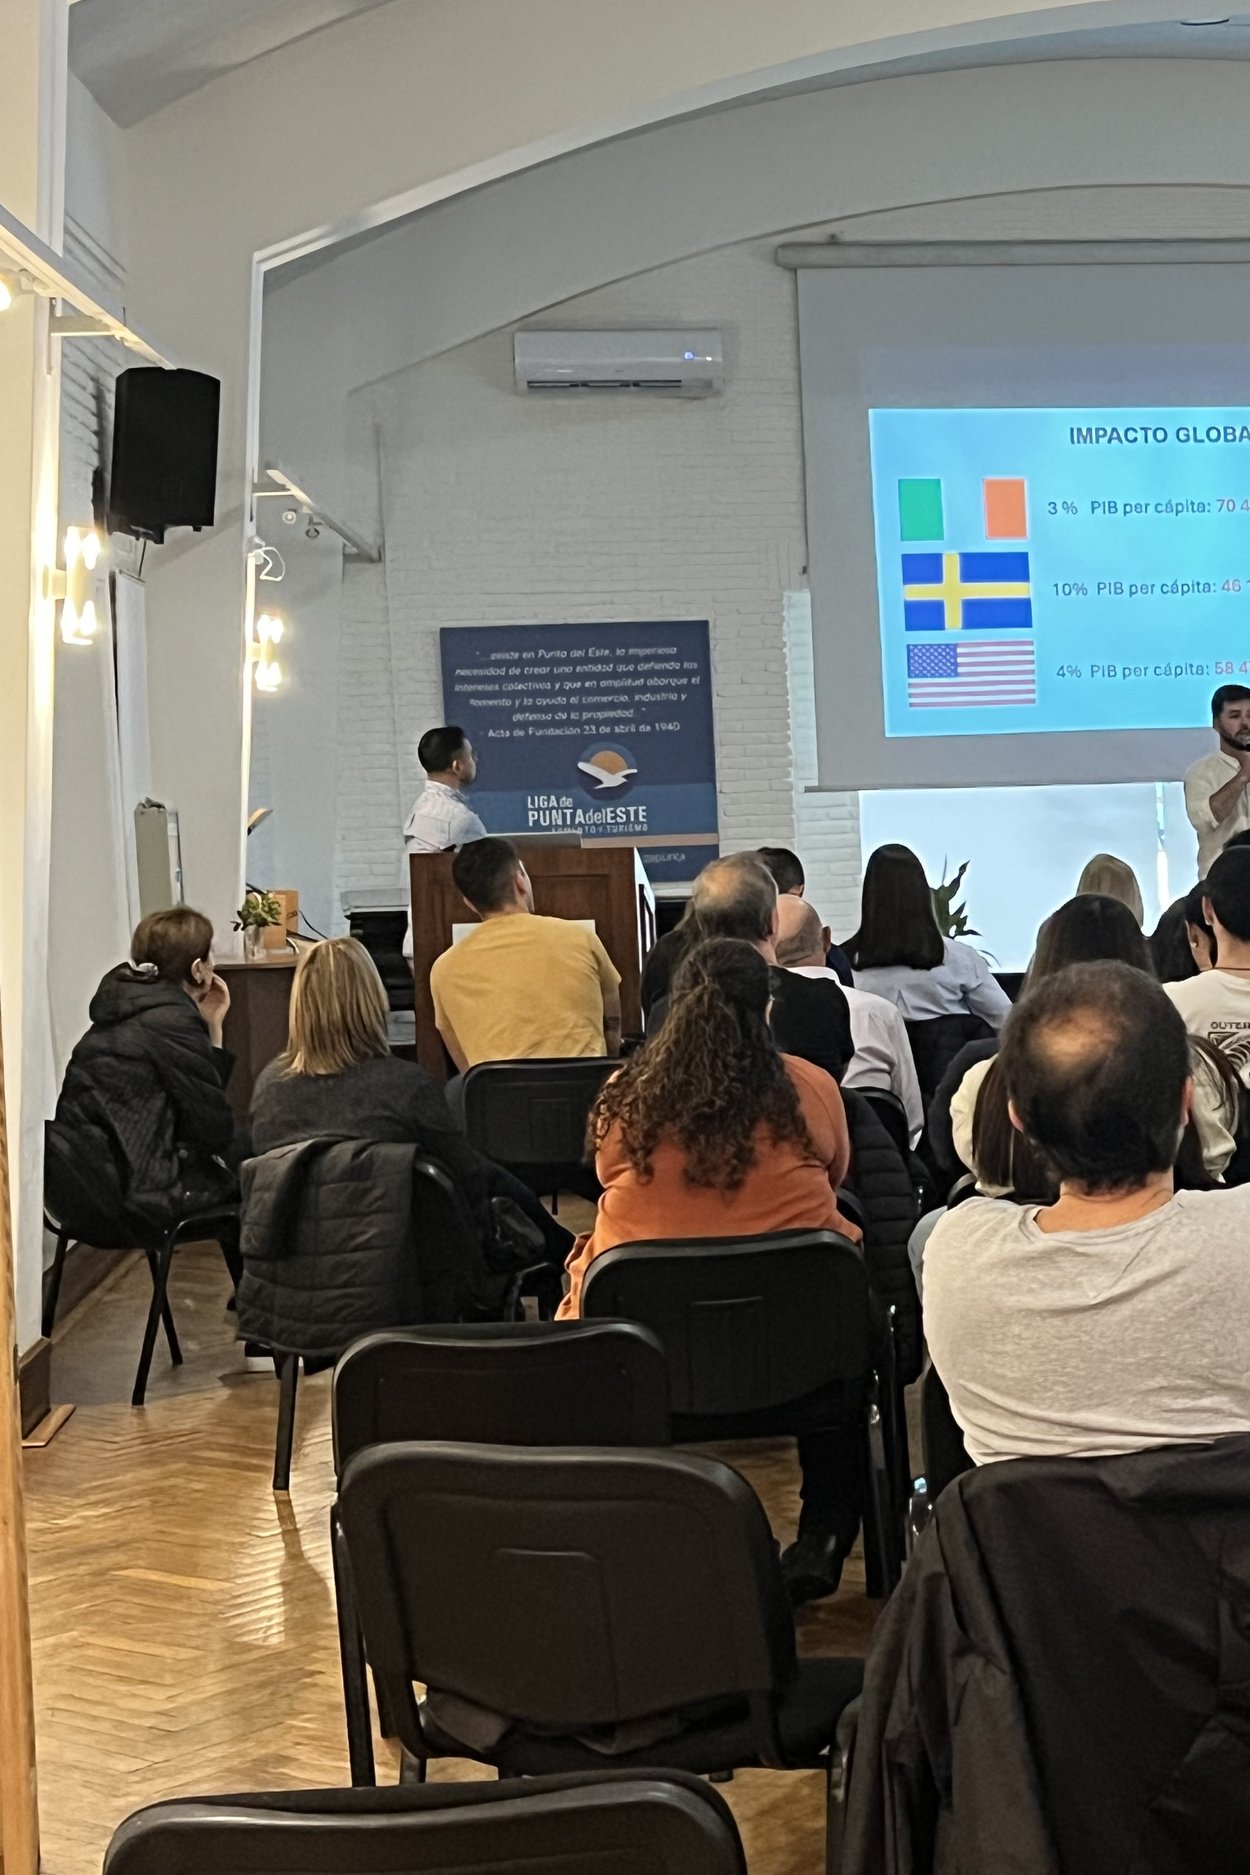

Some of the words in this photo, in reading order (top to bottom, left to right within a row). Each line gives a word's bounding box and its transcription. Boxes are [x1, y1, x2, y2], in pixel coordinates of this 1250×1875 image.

[1069, 426, 1168, 445] IMPACTO
[1048, 502, 1058, 515] 3
[1062, 501, 1078, 515] %
[1091, 501, 1118, 515] PIB
[1123, 502, 1150, 517] per
[1154, 499, 1211, 517] cápita:
[1216, 499, 1236, 513] 70
[1053, 582, 1088, 597] 10%
[1097, 581, 1124, 595] PIB
[1129, 583, 1155, 598] per
[1160, 579, 1217, 596] cápita:
[1221, 579, 1242, 593] 46
[524, 666, 550, 674] crear
[1056, 665, 1082, 678] 4%
[1090, 664, 1117, 678] PIB
[1122, 666, 1149, 680] per
[1153, 662, 1210, 679] cápita:
[1215, 661, 1234, 675] 58
[513, 729, 525, 737] de
[599, 725, 611, 733] de
[638, 724, 651, 732] de
[527, 795, 558, 809] LIGA
[559, 796, 573, 807] de
[1211, 1021, 1250, 1029] OUTER
